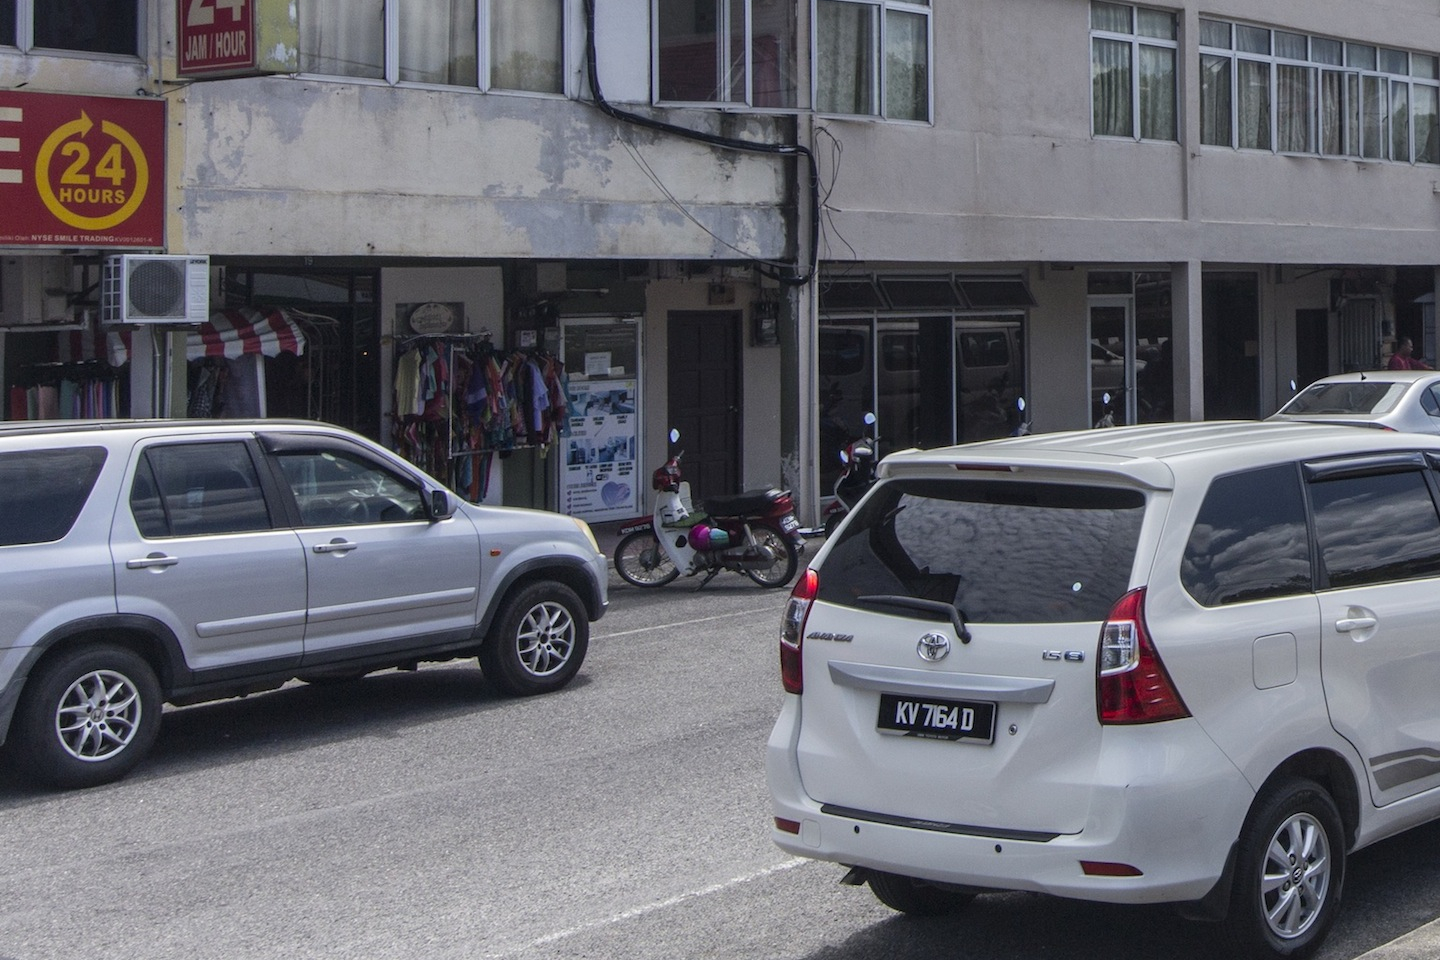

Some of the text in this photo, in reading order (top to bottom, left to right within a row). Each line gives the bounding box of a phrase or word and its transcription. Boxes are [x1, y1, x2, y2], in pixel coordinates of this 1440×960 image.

[185, 35, 208, 61] JAM
[215, 30, 246, 58] HOUR
[60, 142, 126, 186] 24
[59, 188, 126, 204] HOURS
[31, 234, 52, 242] NYSE
[54, 234, 78, 242] SMILE
[80, 235, 114, 243] TRADING
[895, 701, 975, 731] KV 7164 D
